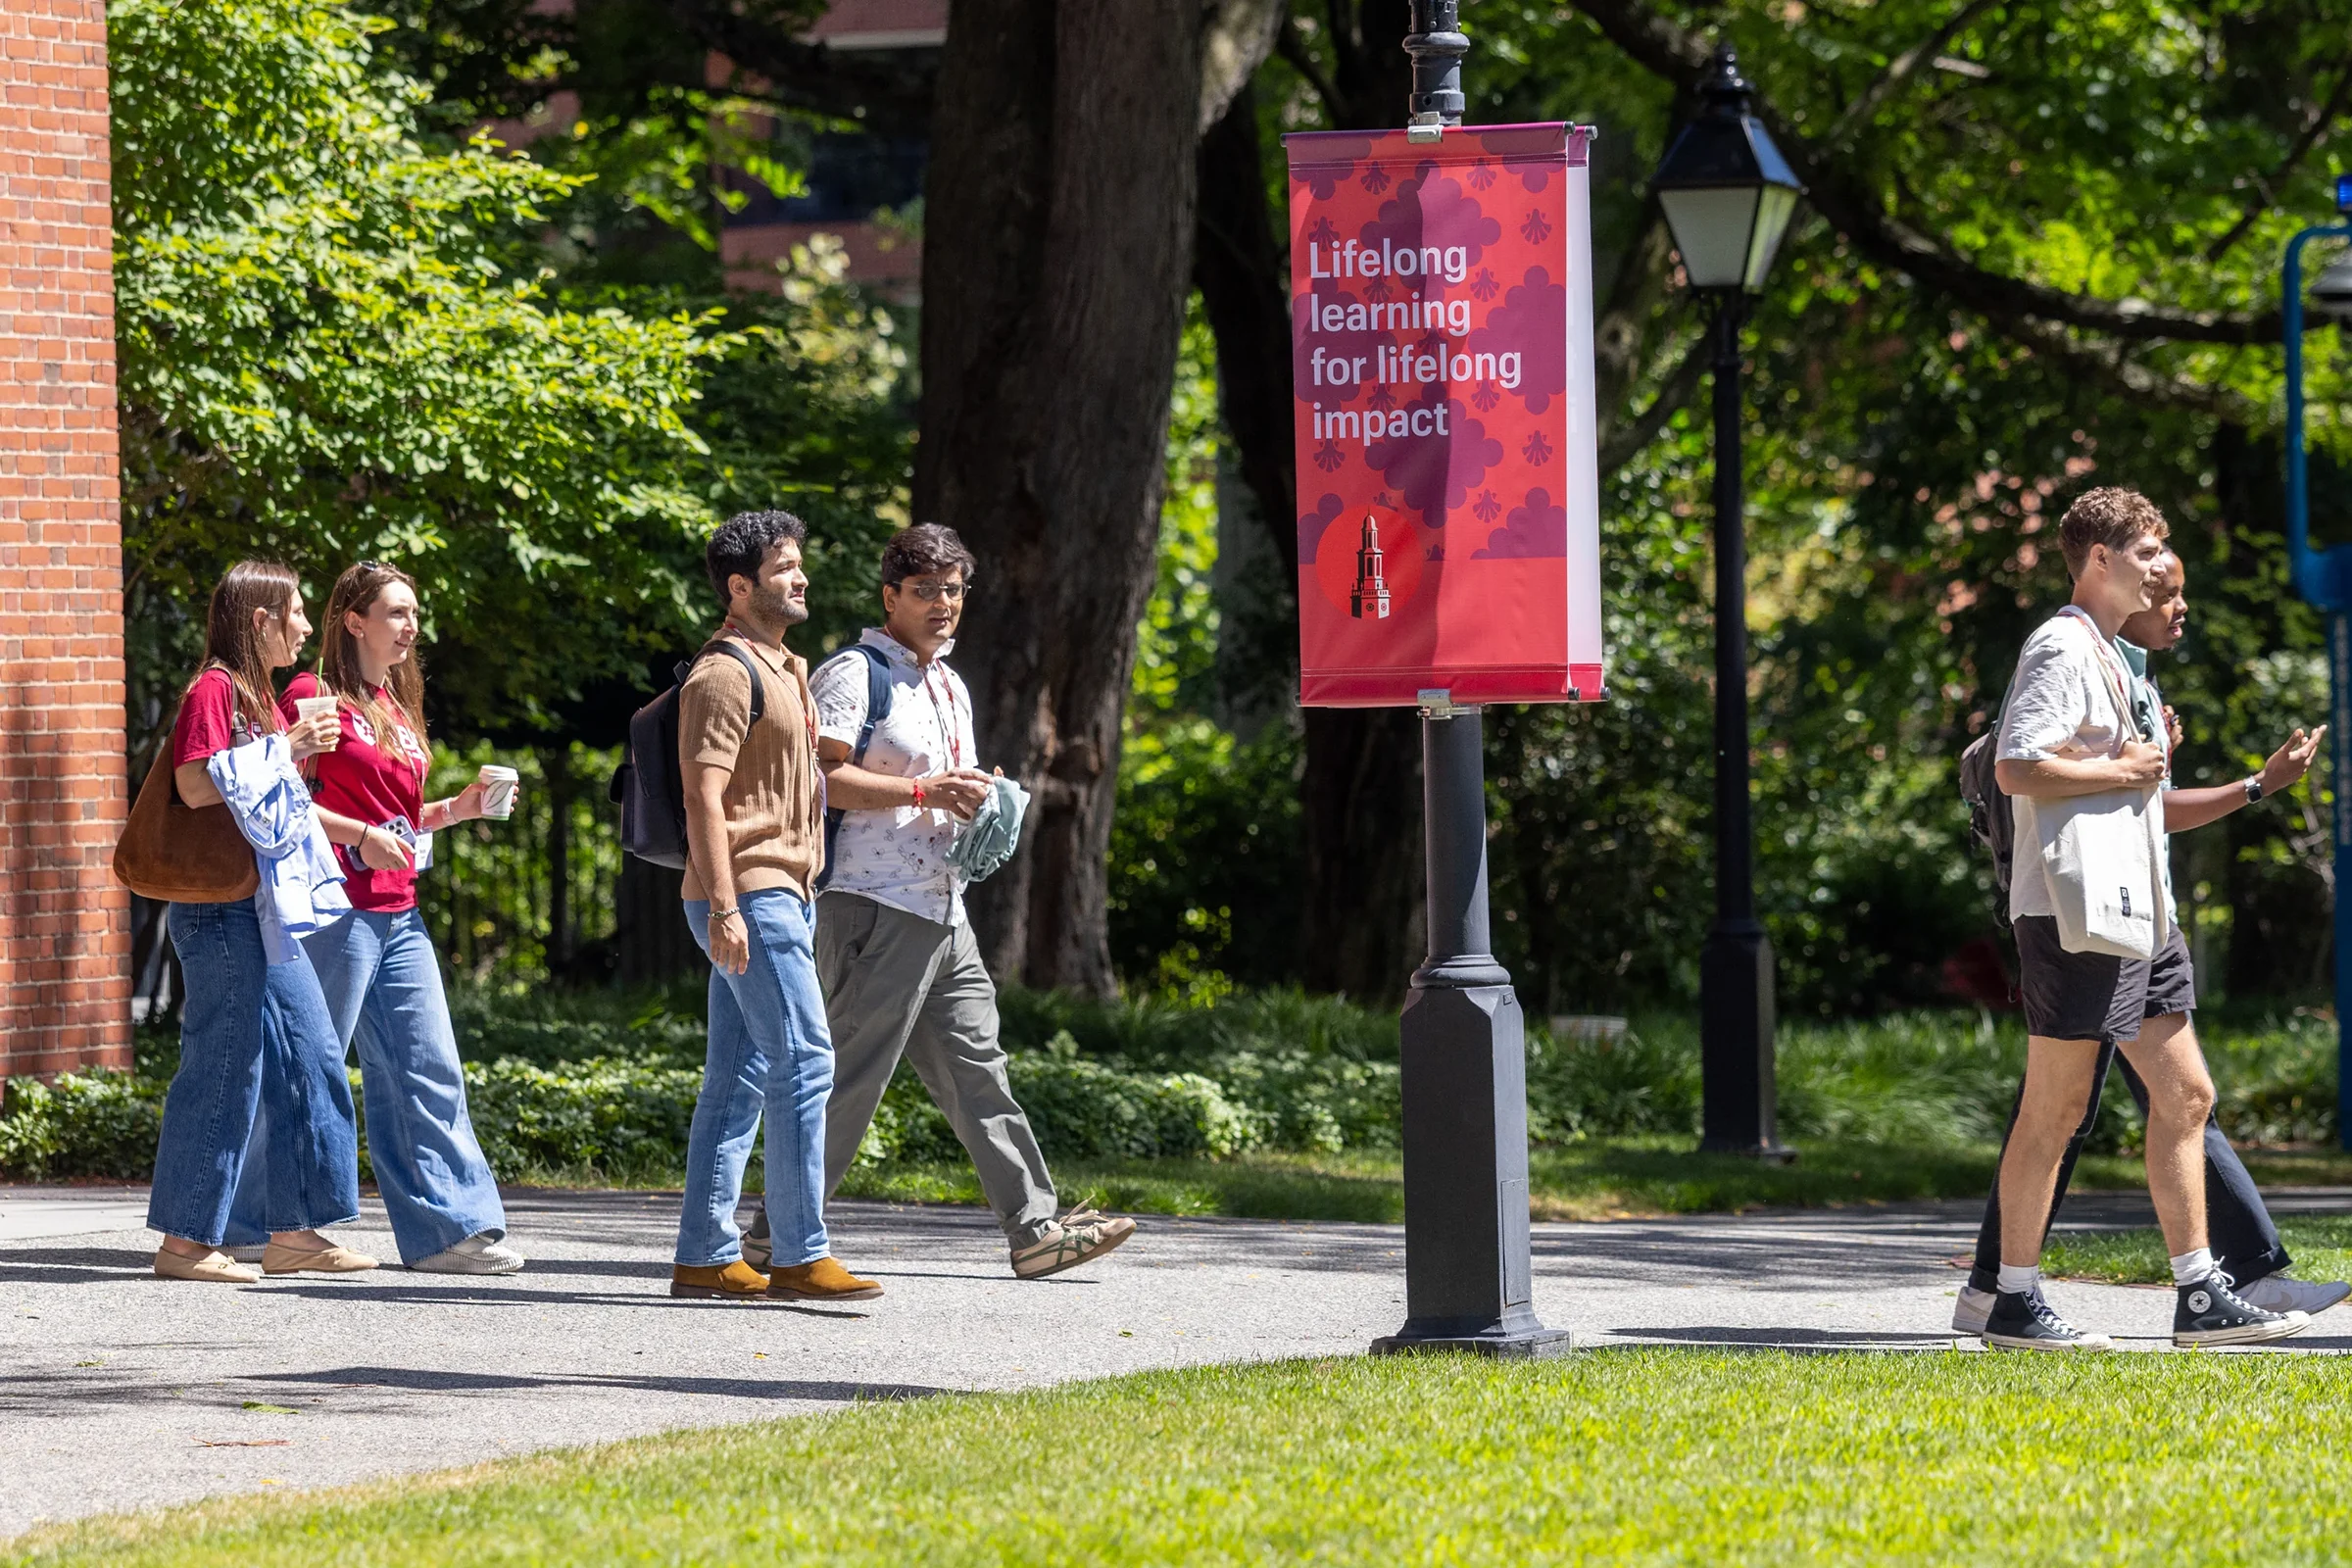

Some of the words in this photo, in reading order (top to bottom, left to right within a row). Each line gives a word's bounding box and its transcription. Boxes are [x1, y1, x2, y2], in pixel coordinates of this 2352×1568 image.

[1309, 238, 1467, 283] Lifelong
[1310, 292, 1470, 337] learning
[1310, 347, 1367, 386] for
[1378, 344, 1521, 389] lifelong
[1313, 402, 1448, 447] impact
